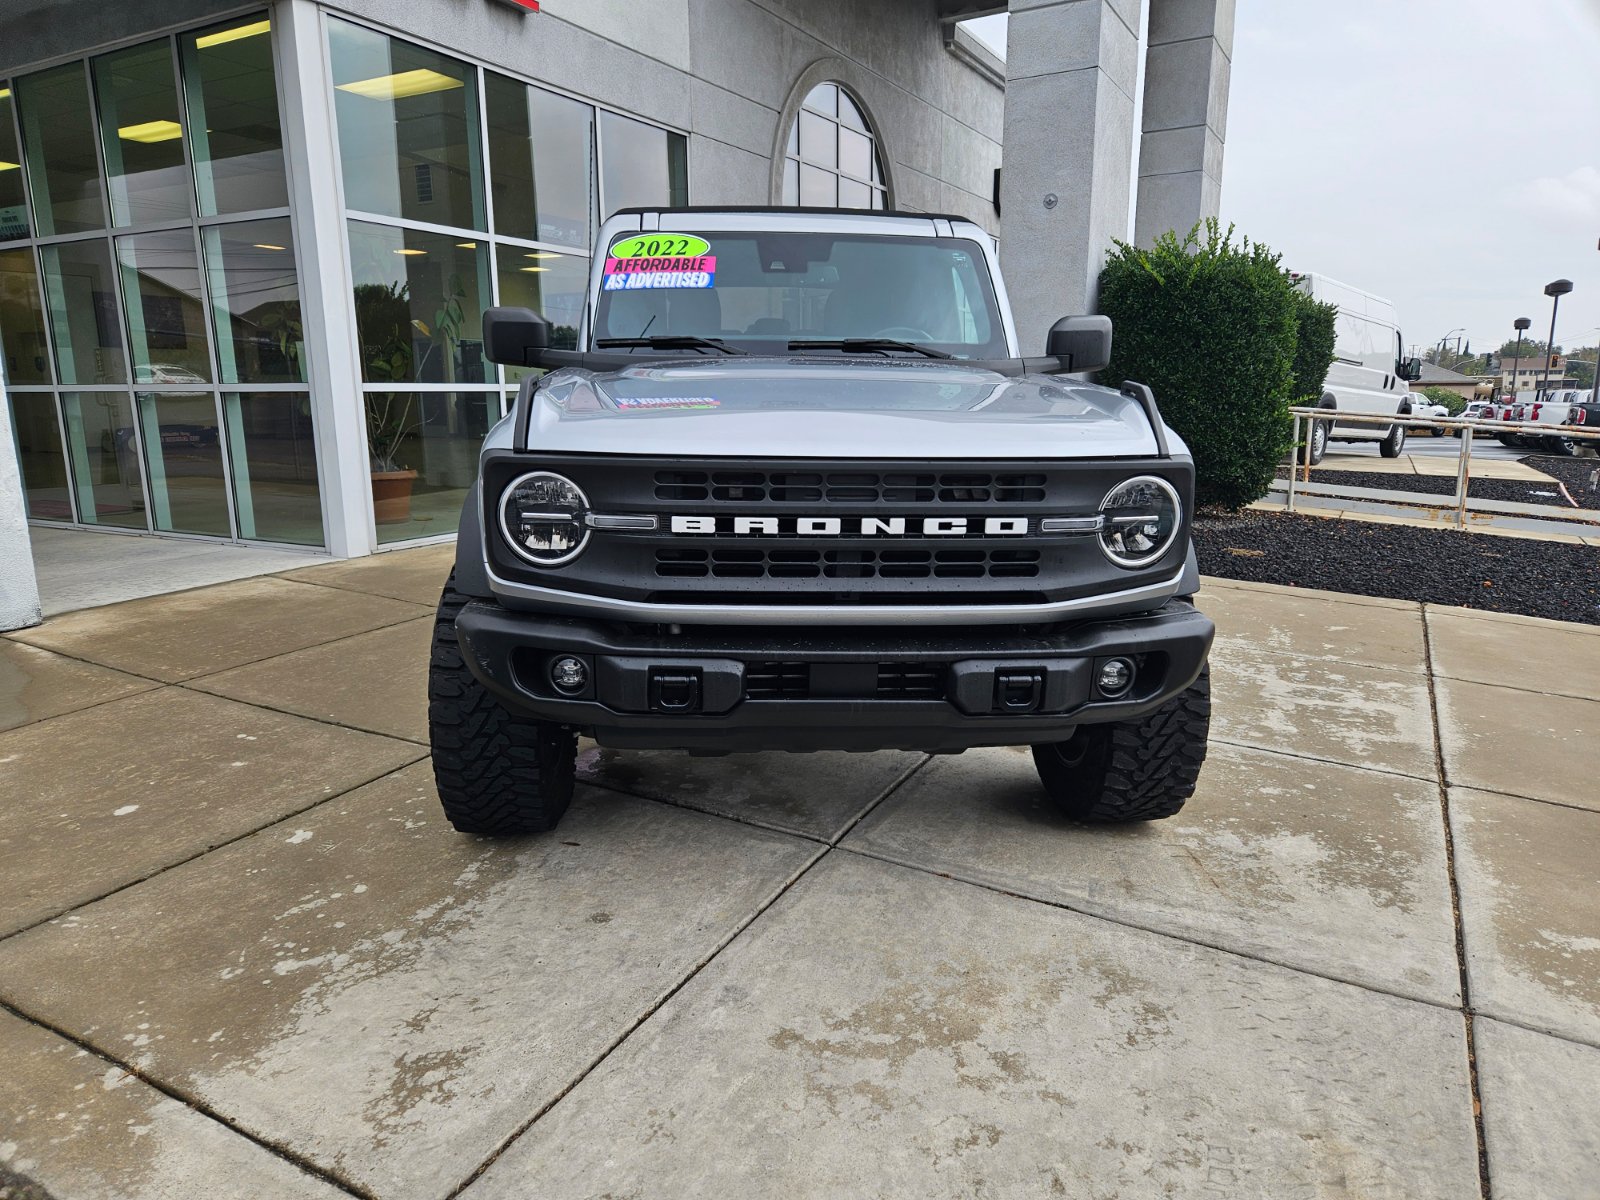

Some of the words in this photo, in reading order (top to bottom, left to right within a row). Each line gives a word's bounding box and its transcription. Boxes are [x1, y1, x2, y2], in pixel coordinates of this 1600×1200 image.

[631, 239, 689, 257] 2022
[613, 258, 706, 272] AFFORDABLE
[605, 274, 625, 290] AS
[626, 272, 710, 288] ADVERTISED
[671, 516, 1028, 535] BRONCO
